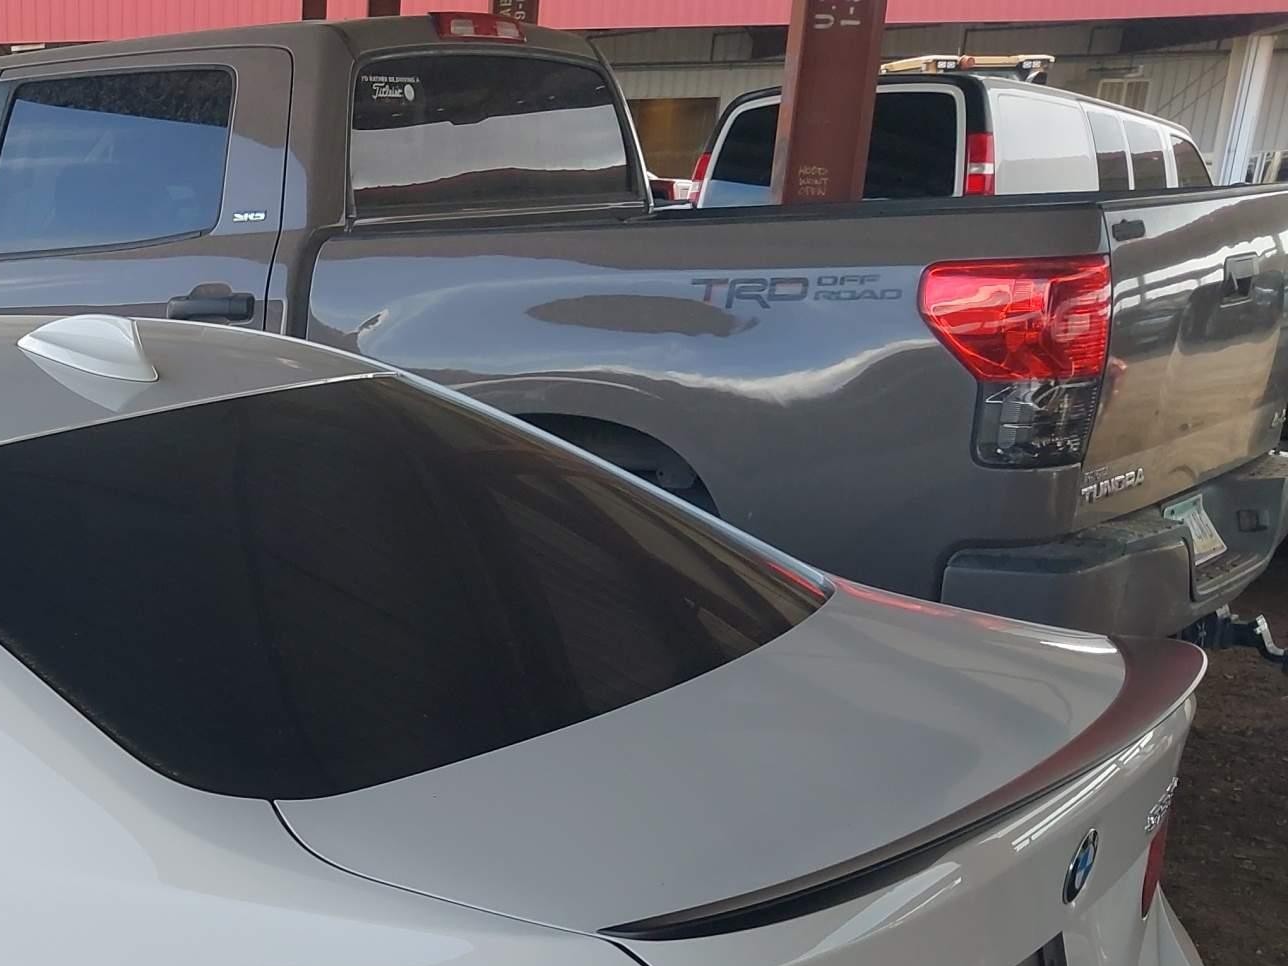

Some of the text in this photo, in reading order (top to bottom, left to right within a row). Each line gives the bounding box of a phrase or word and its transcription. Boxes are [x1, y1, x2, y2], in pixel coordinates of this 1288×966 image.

[816, 274, 880, 287] OFF
[691, 276, 809, 309] TRD
[814, 289, 902, 301] ROAD
[1081, 467, 1145, 503] TUNDRA
